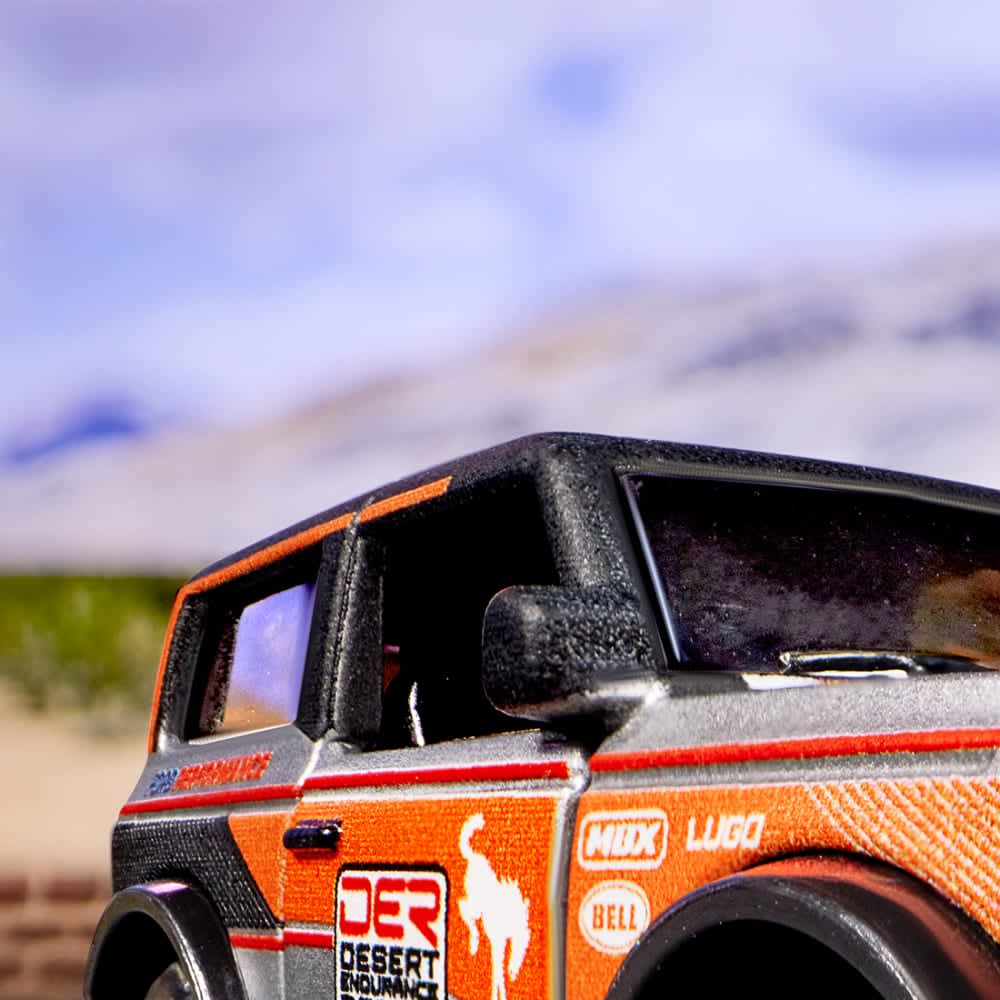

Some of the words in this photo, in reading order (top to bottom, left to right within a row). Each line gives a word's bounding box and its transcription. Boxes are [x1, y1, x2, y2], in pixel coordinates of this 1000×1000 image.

[685, 813, 765, 851] LUGO
[339, 876, 441, 949] DER
[591, 903, 638, 931] BELL
[340, 942, 440, 979] DESERT
